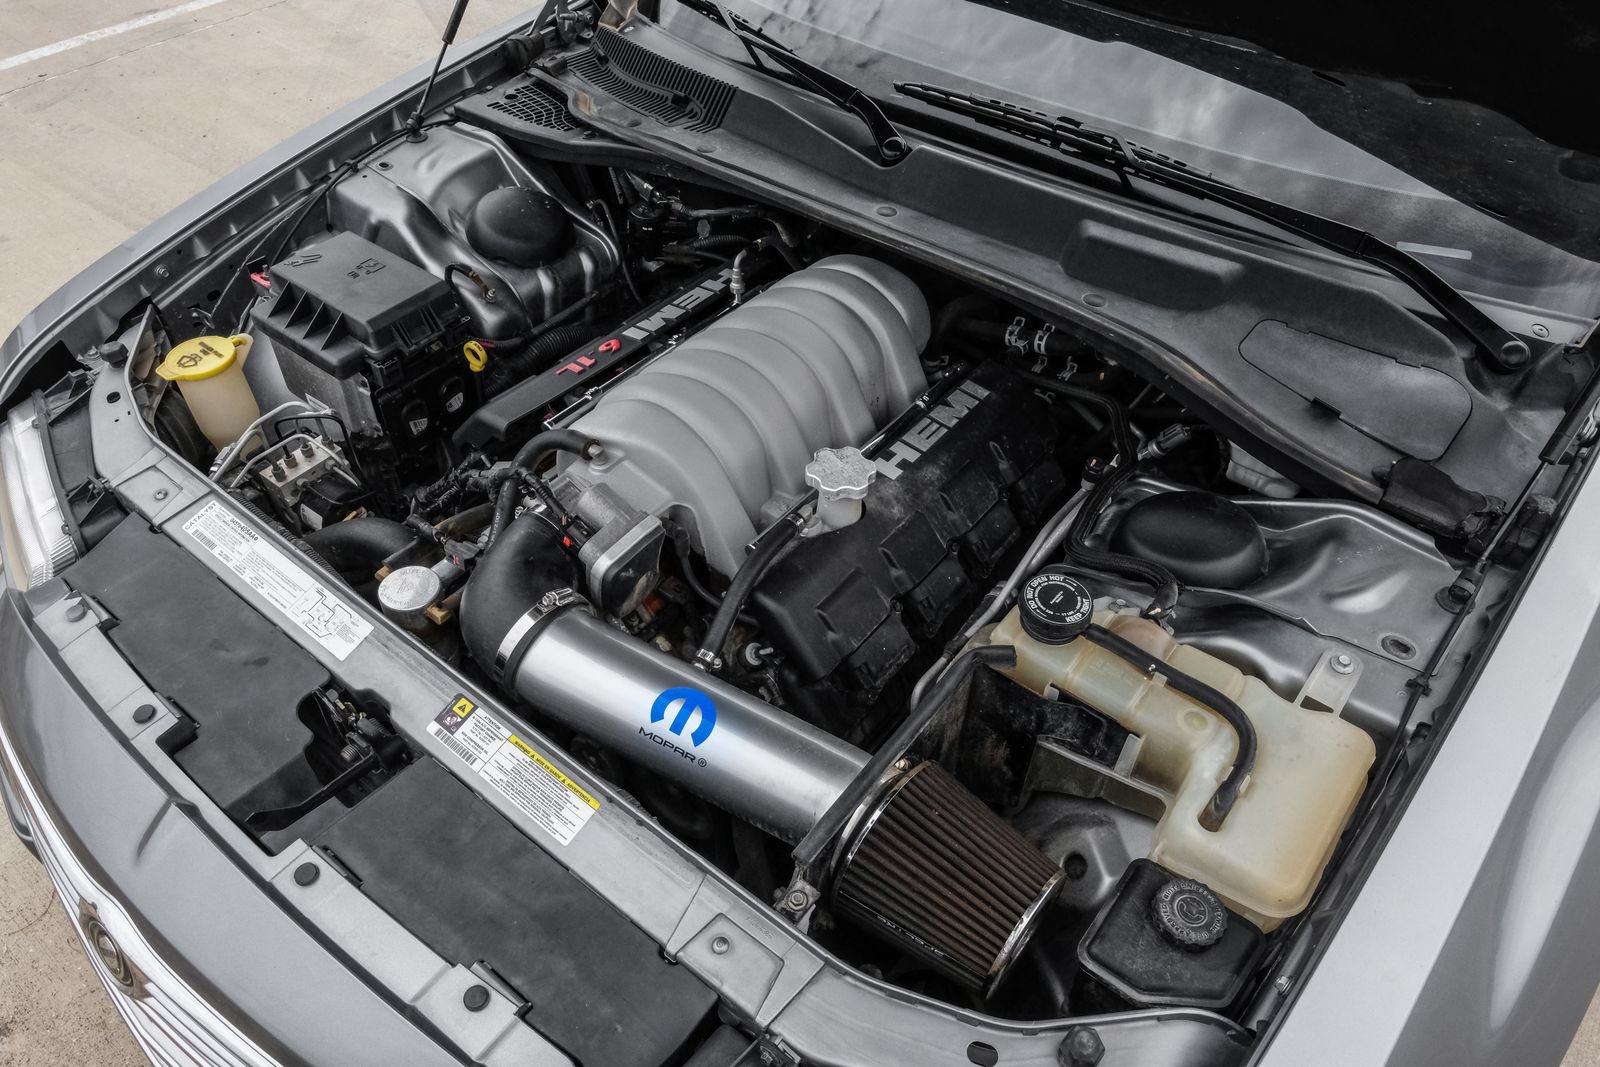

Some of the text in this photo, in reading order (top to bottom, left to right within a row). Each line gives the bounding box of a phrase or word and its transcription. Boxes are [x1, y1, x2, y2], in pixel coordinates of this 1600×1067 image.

[622, 268, 735, 340] HEMI
[556, 338, 622, 374] 6.1L
[875, 380, 991, 480] HEMI
[184, 502, 217, 530] CATALYST
[1031, 576, 1048, 587] OPEN
[1028, 600, 1038, 609] DO
[1066, 613, 1082, 622] KEEP
[1080, 598, 1090, 613] TIGHT
[484, 716, 502, 730] ATTENTION
[638, 726, 696, 762] MOPAR
